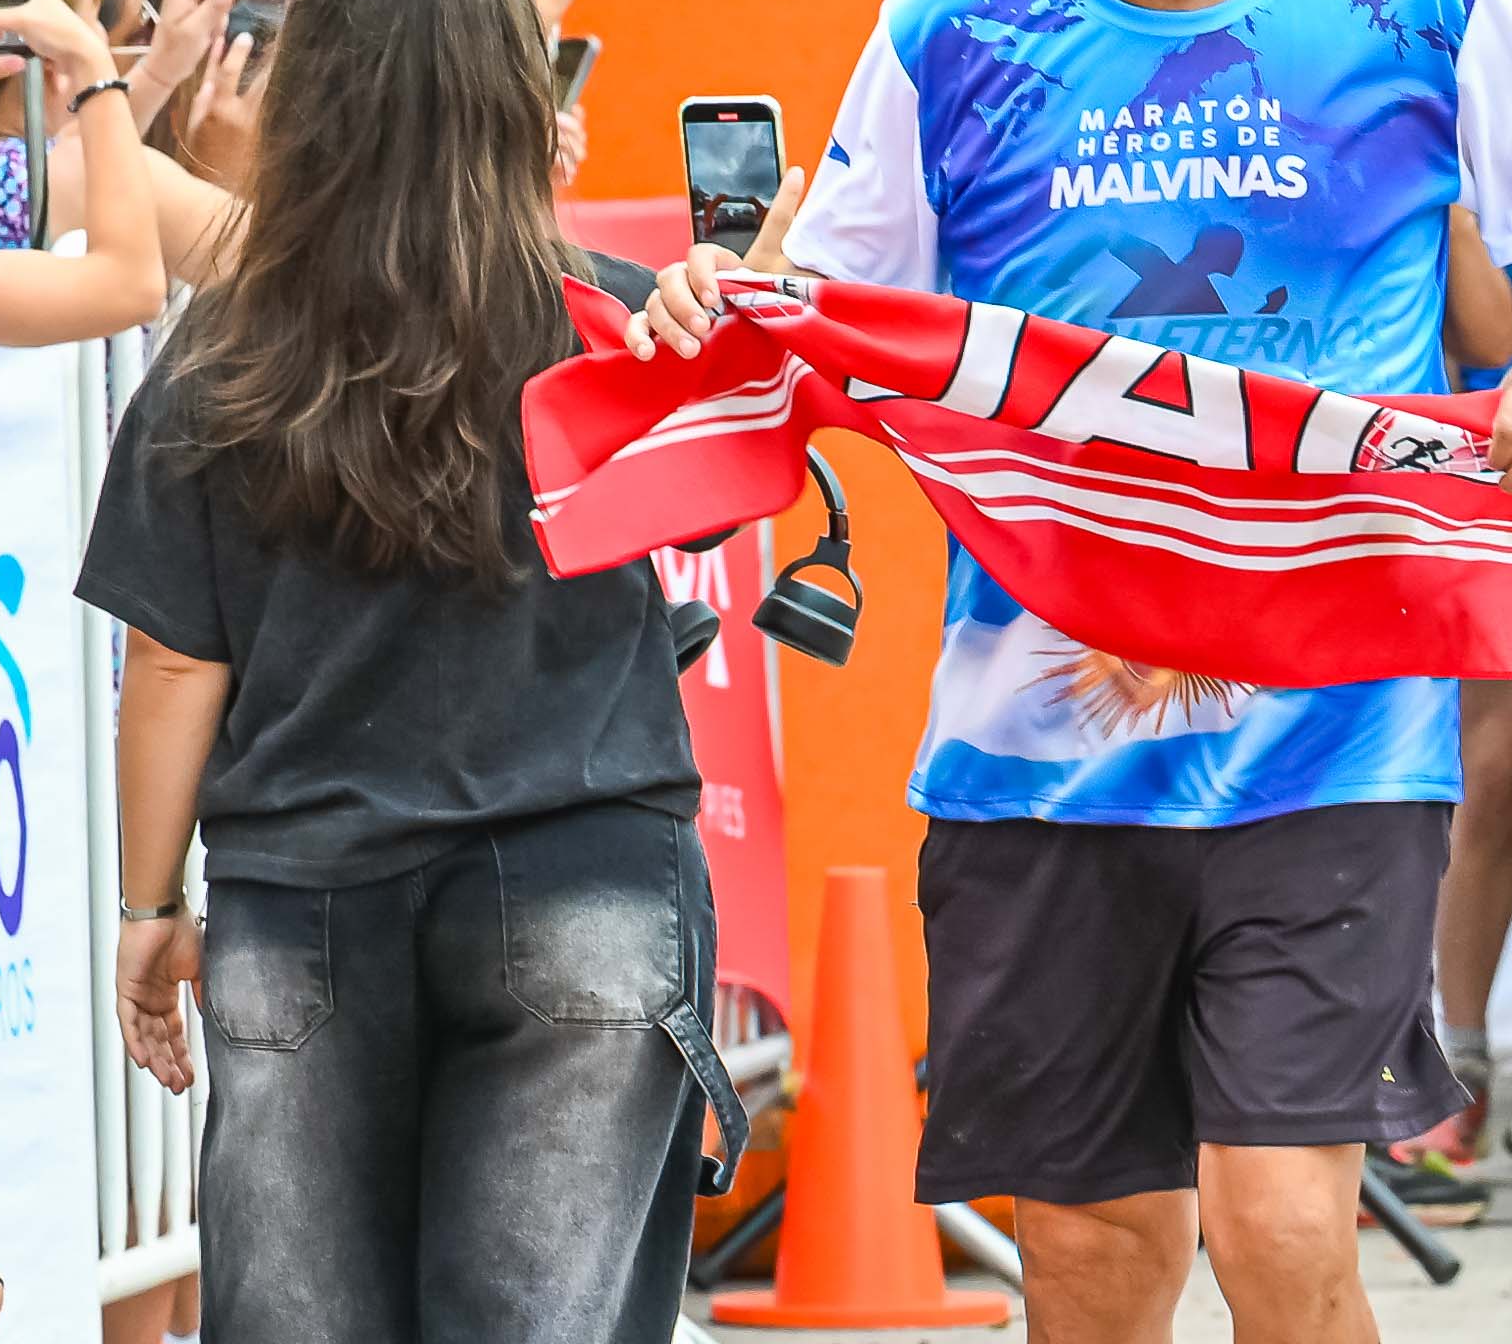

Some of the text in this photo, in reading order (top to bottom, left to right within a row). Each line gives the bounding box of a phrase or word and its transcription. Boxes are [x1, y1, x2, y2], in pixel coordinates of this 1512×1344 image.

[1079, 94, 1281, 132] MARATÓN
[1077, 126, 1281, 157] HÉROES DE
[1049, 154, 1308, 210] MALVINAS
